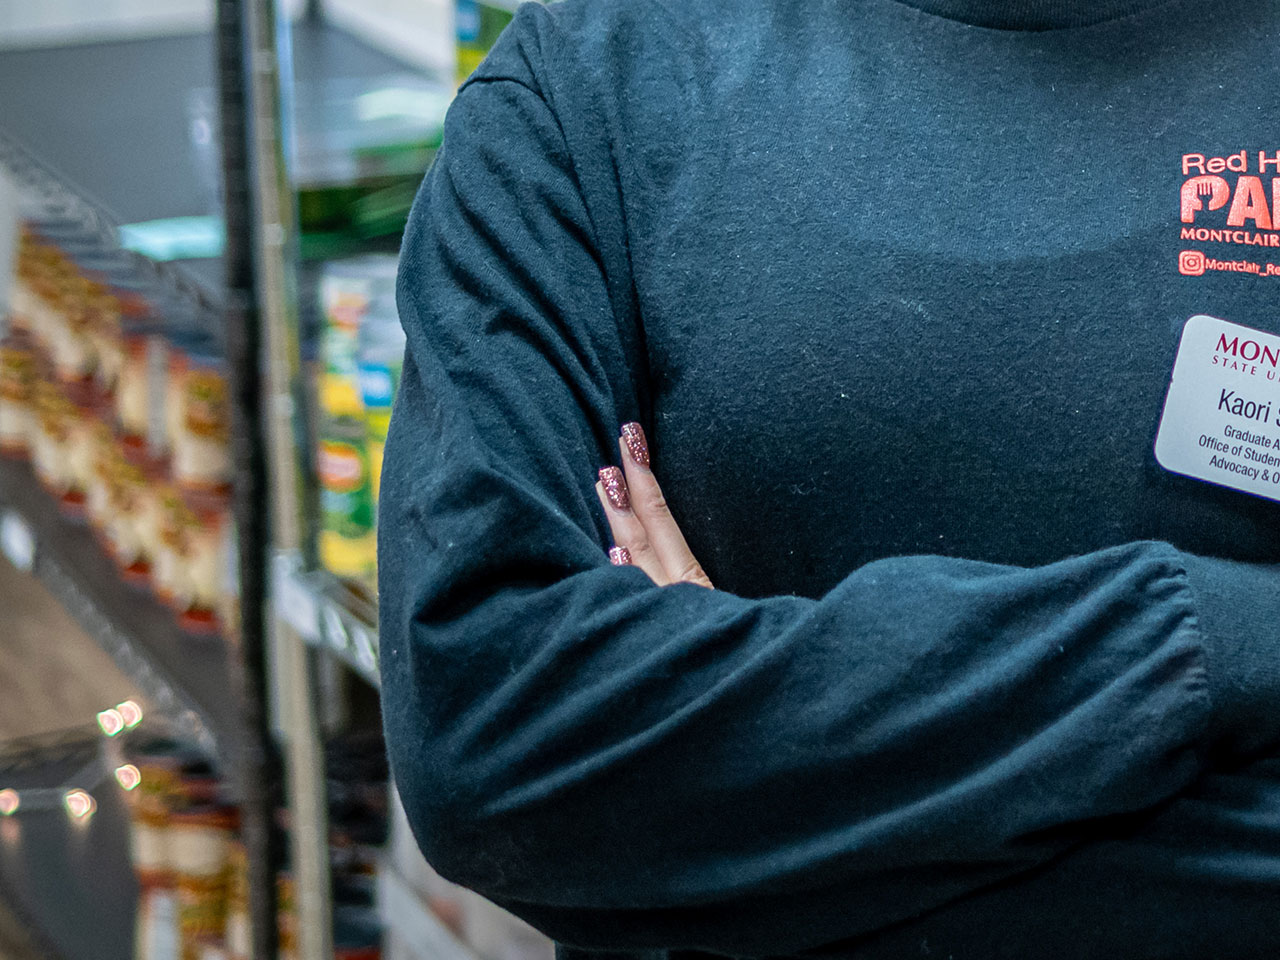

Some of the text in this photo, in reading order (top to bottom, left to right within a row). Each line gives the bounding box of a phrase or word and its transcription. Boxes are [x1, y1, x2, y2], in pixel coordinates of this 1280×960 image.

[1181, 150, 1247, 176] Red
[1180, 227, 1280, 248] MONTCLAIR
[1211, 354, 1258, 377] STATE
[1218, 389, 1272, 424] Kaori
[1198, 434, 1230, 454] Office
[1231, 442, 1243, 457] of
[1224, 425, 1271, 449] Graduate
[1209, 455, 1260, 481] Advocacy
[1261, 469, 1270, 481] &
